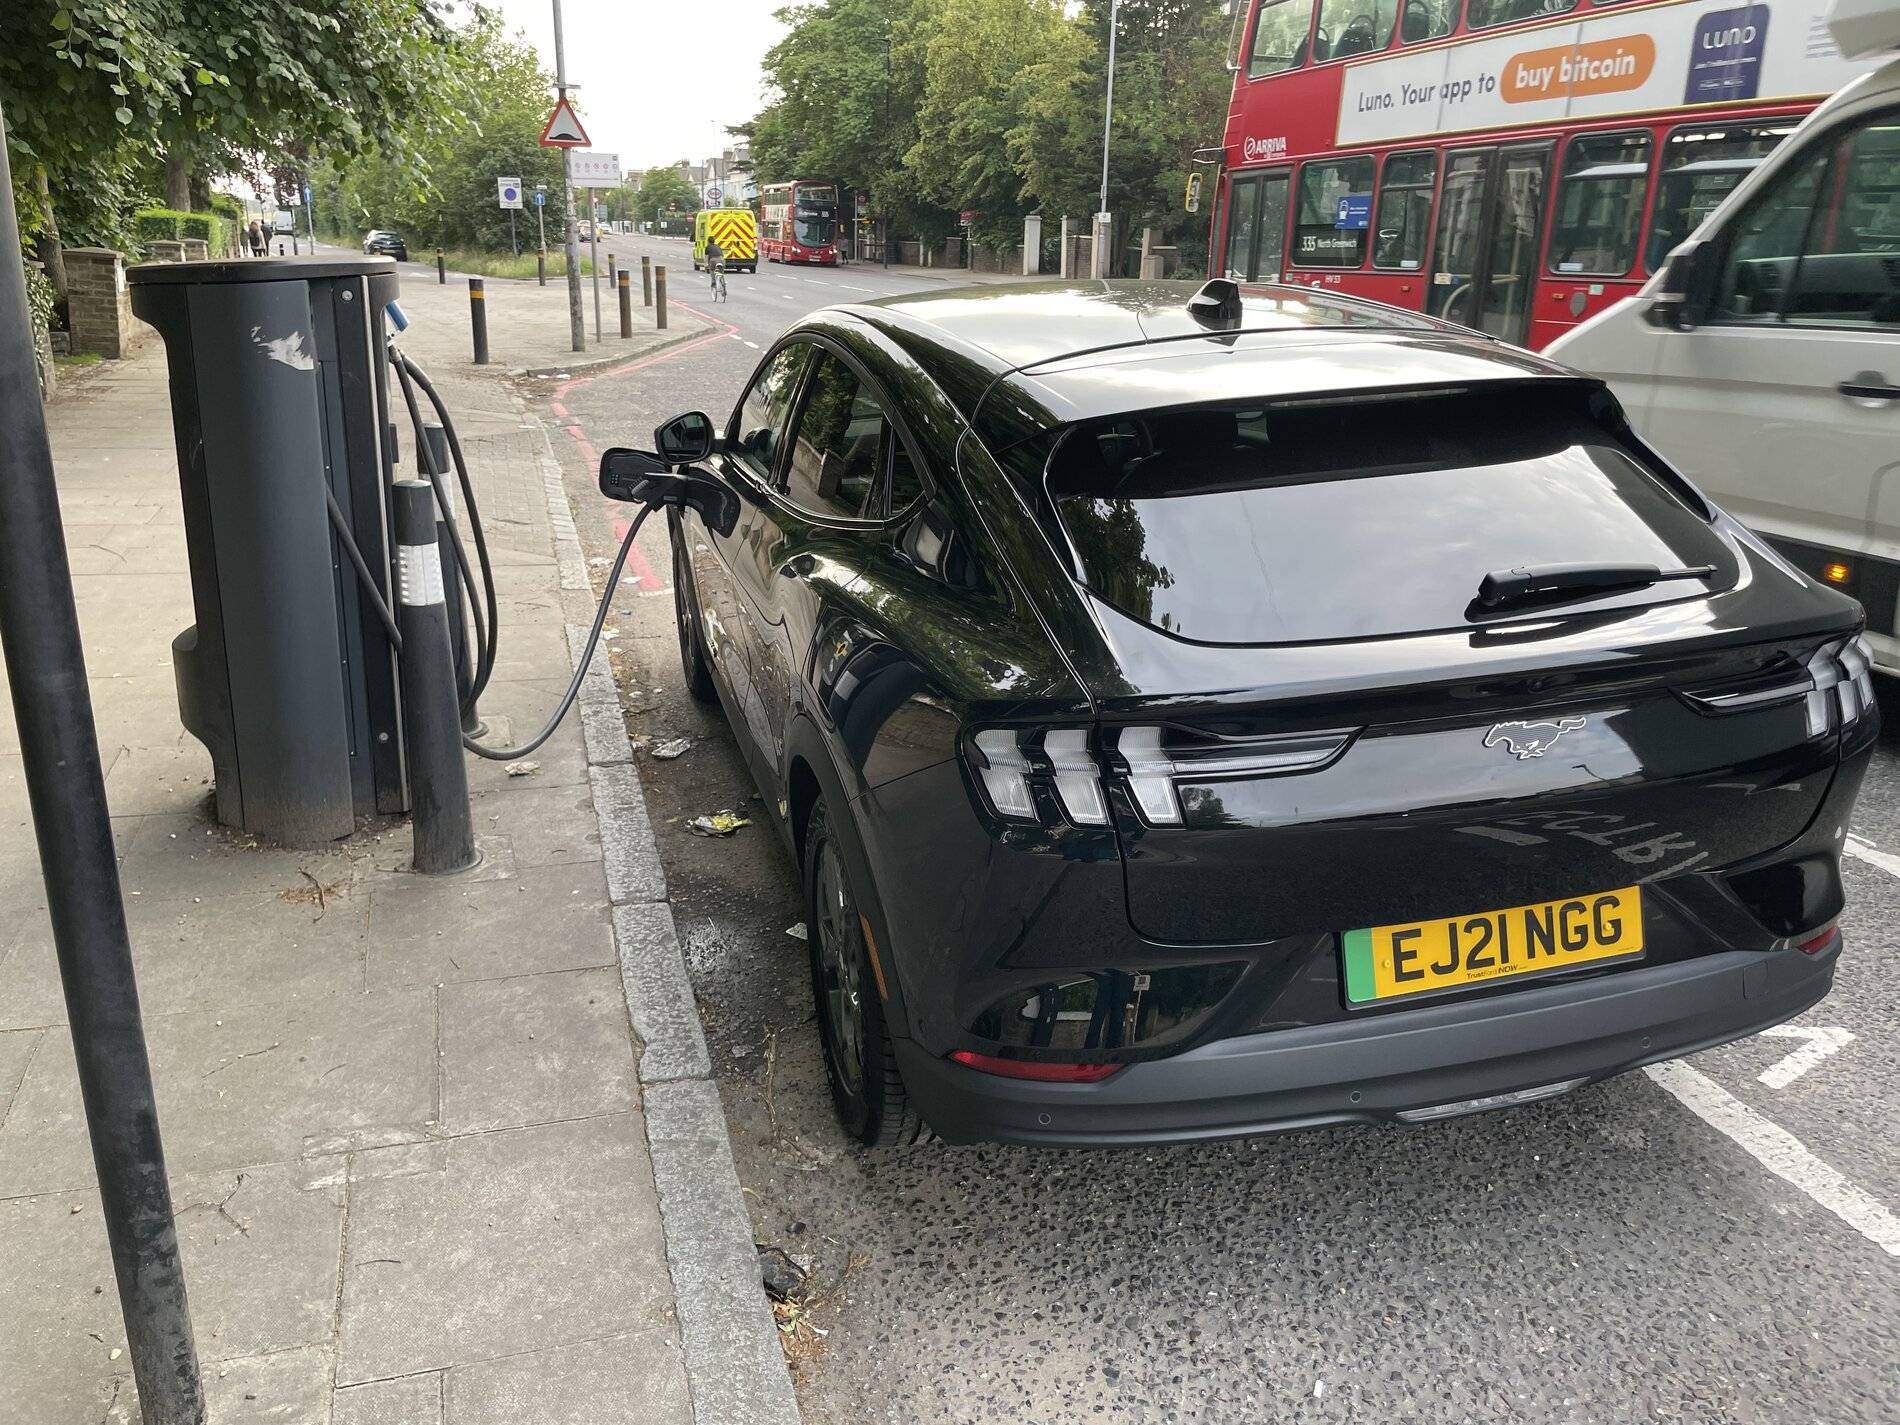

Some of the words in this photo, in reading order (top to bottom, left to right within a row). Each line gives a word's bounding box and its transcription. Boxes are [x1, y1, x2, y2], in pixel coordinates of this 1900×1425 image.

[1358, 91, 1394, 112] Luno.
[1401, 82, 1436, 106] Your
[1439, 78, 1472, 104] app
[1478, 72, 1496, 93] to
[1515, 63, 1555, 92] buy
[1558, 48, 1636, 83] bitcoin
[1255, 136, 1287, 154] ARRIVA
[1392, 914, 1509, 983] EJ21
[1524, 895, 1621, 960] NGG
